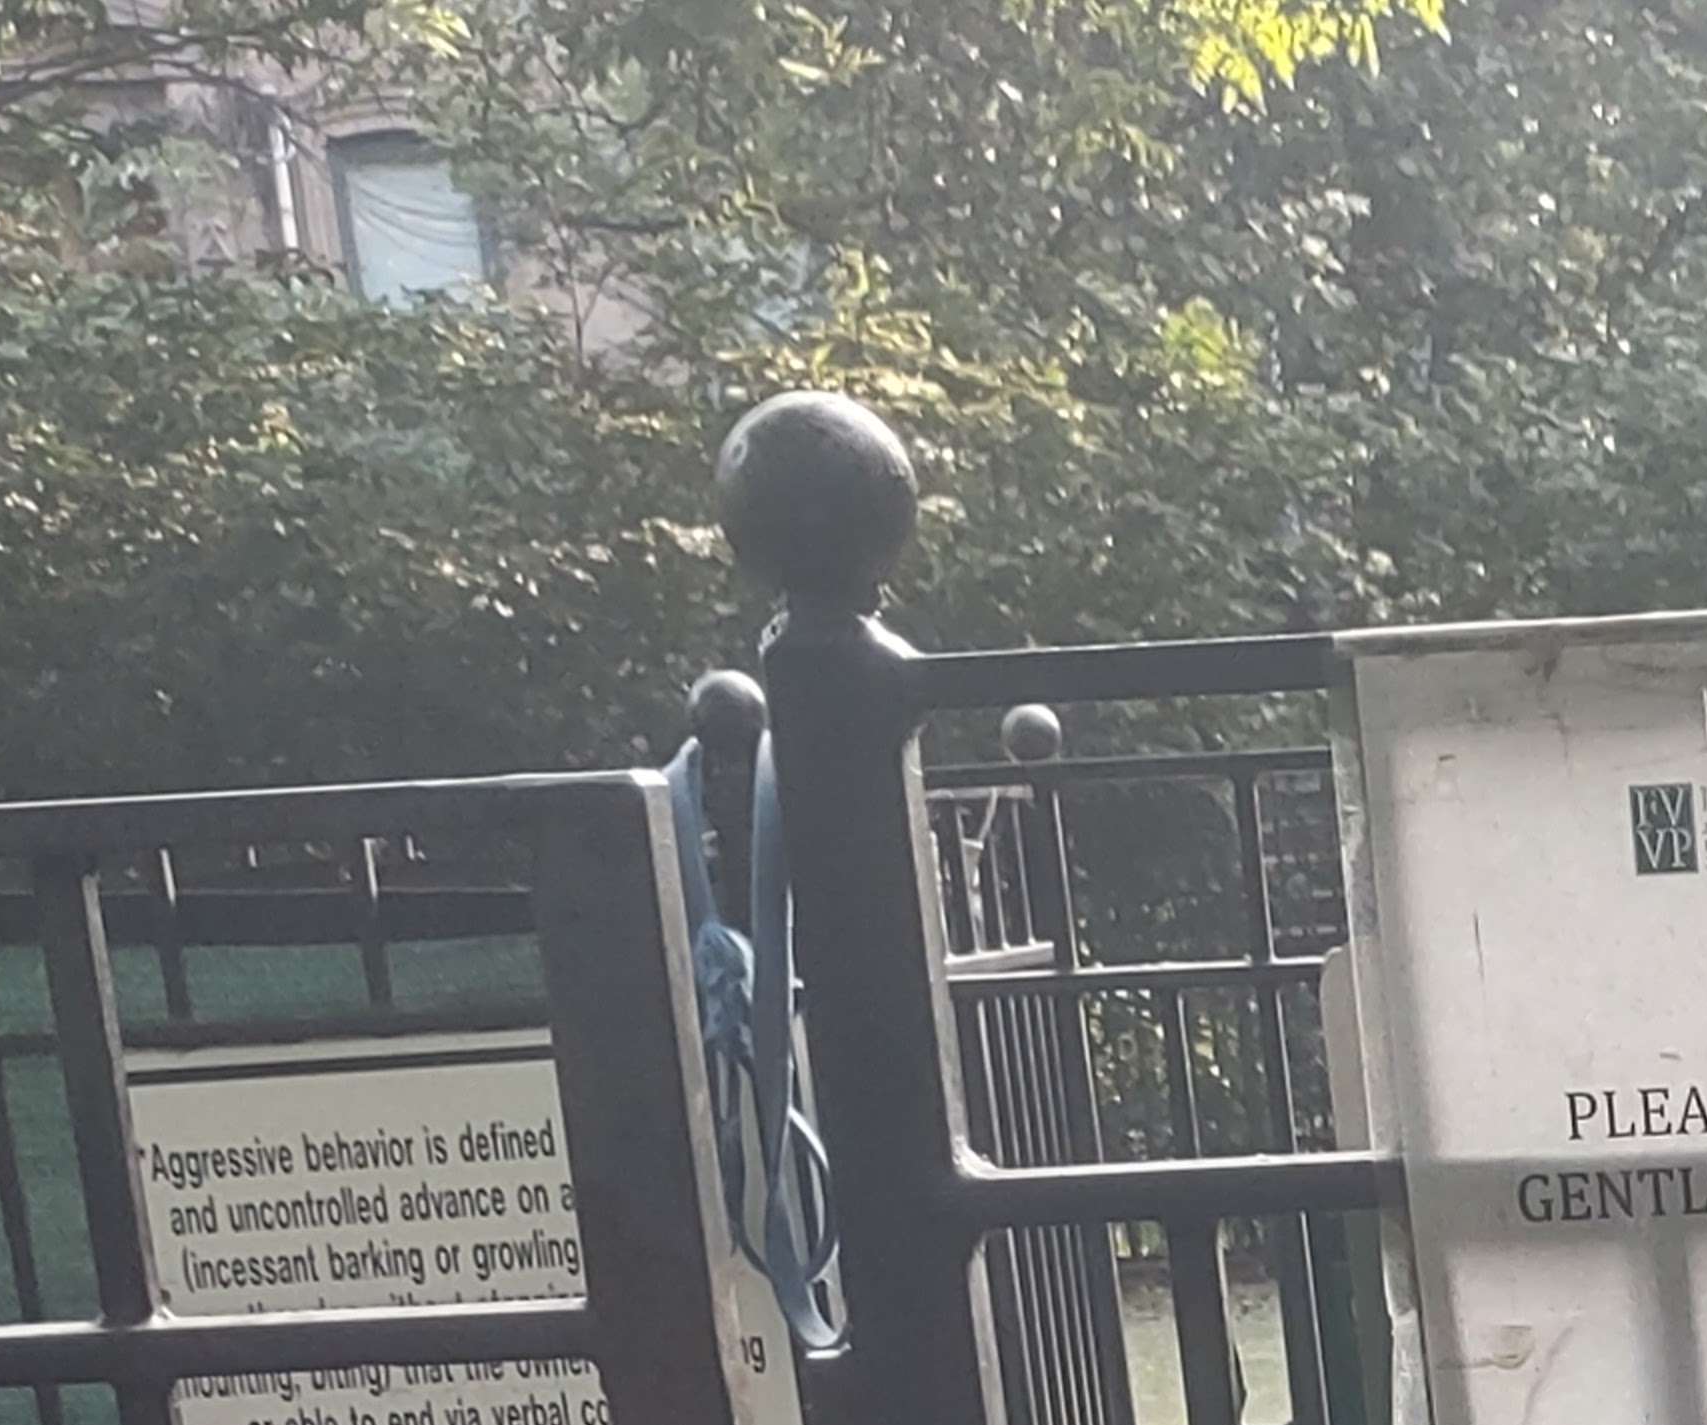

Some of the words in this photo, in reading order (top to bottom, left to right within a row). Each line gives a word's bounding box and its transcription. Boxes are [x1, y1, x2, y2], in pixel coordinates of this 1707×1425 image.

[303, 1128, 415, 1173] behavior
[425, 1126, 449, 1165] is
[460, 1118, 556, 1162] defined
[171, 1196, 218, 1236] and
[229, 1185, 390, 1233] uncontrolled
[400, 1179, 507, 1222] advance
[517, 1183, 551, 1214] on
[183, 1244, 319, 1292] (incessant
[328, 1239, 425, 1285] barking
[435, 1243, 461, 1276] or
[473, 1229, 581, 1282] growling
